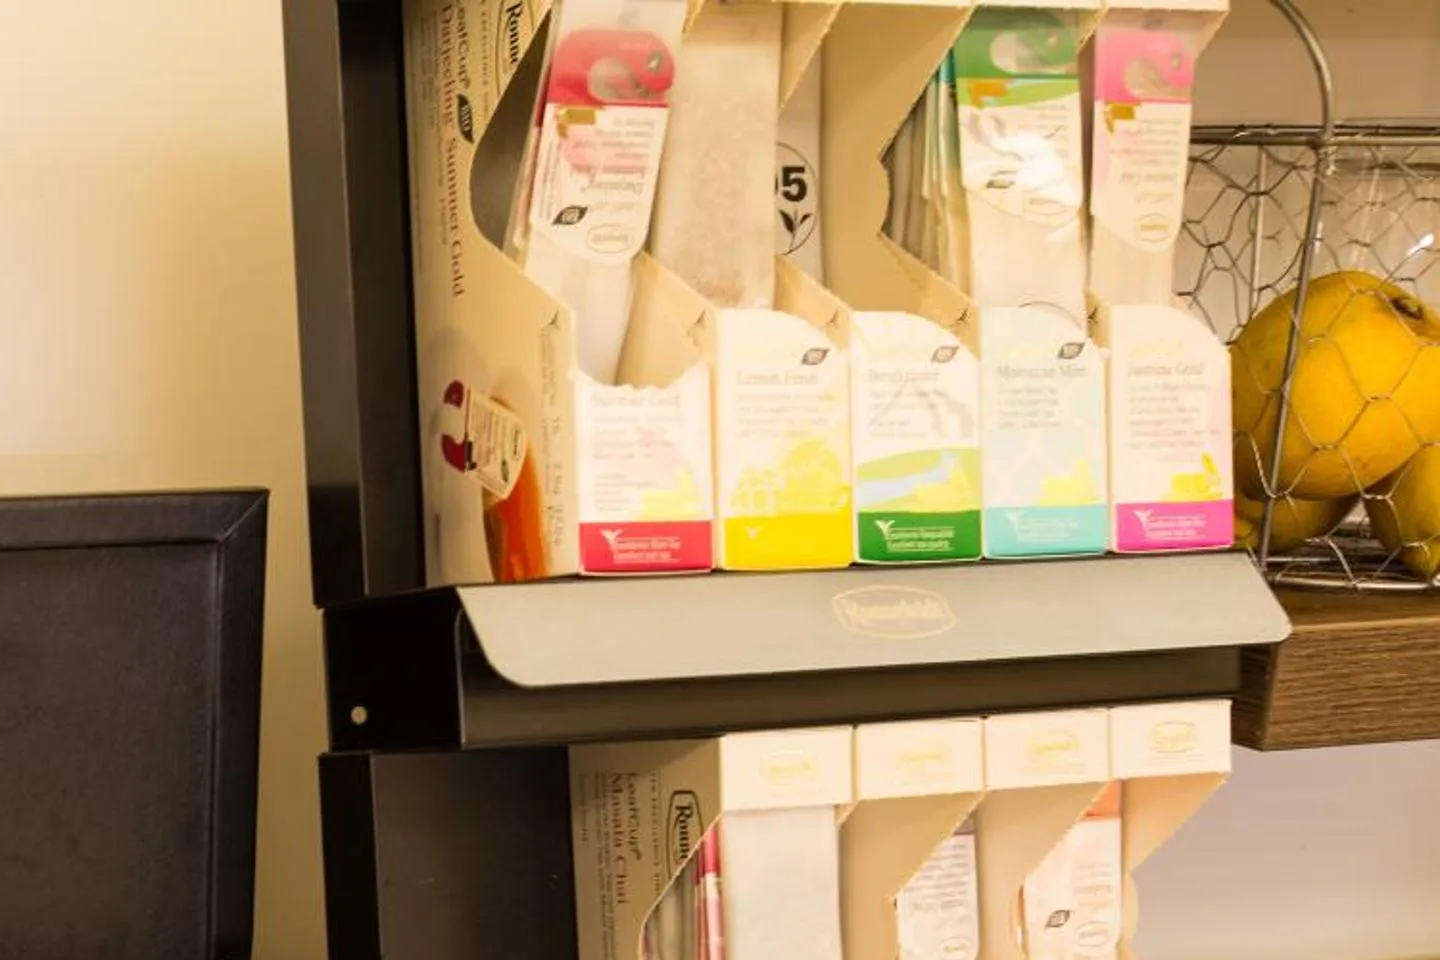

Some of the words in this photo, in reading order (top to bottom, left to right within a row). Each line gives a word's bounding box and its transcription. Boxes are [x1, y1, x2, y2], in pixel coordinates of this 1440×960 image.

[446, 137, 459, 232] Summer
[775, 166, 808, 202] 5
[451, 239, 466, 298] Gold
